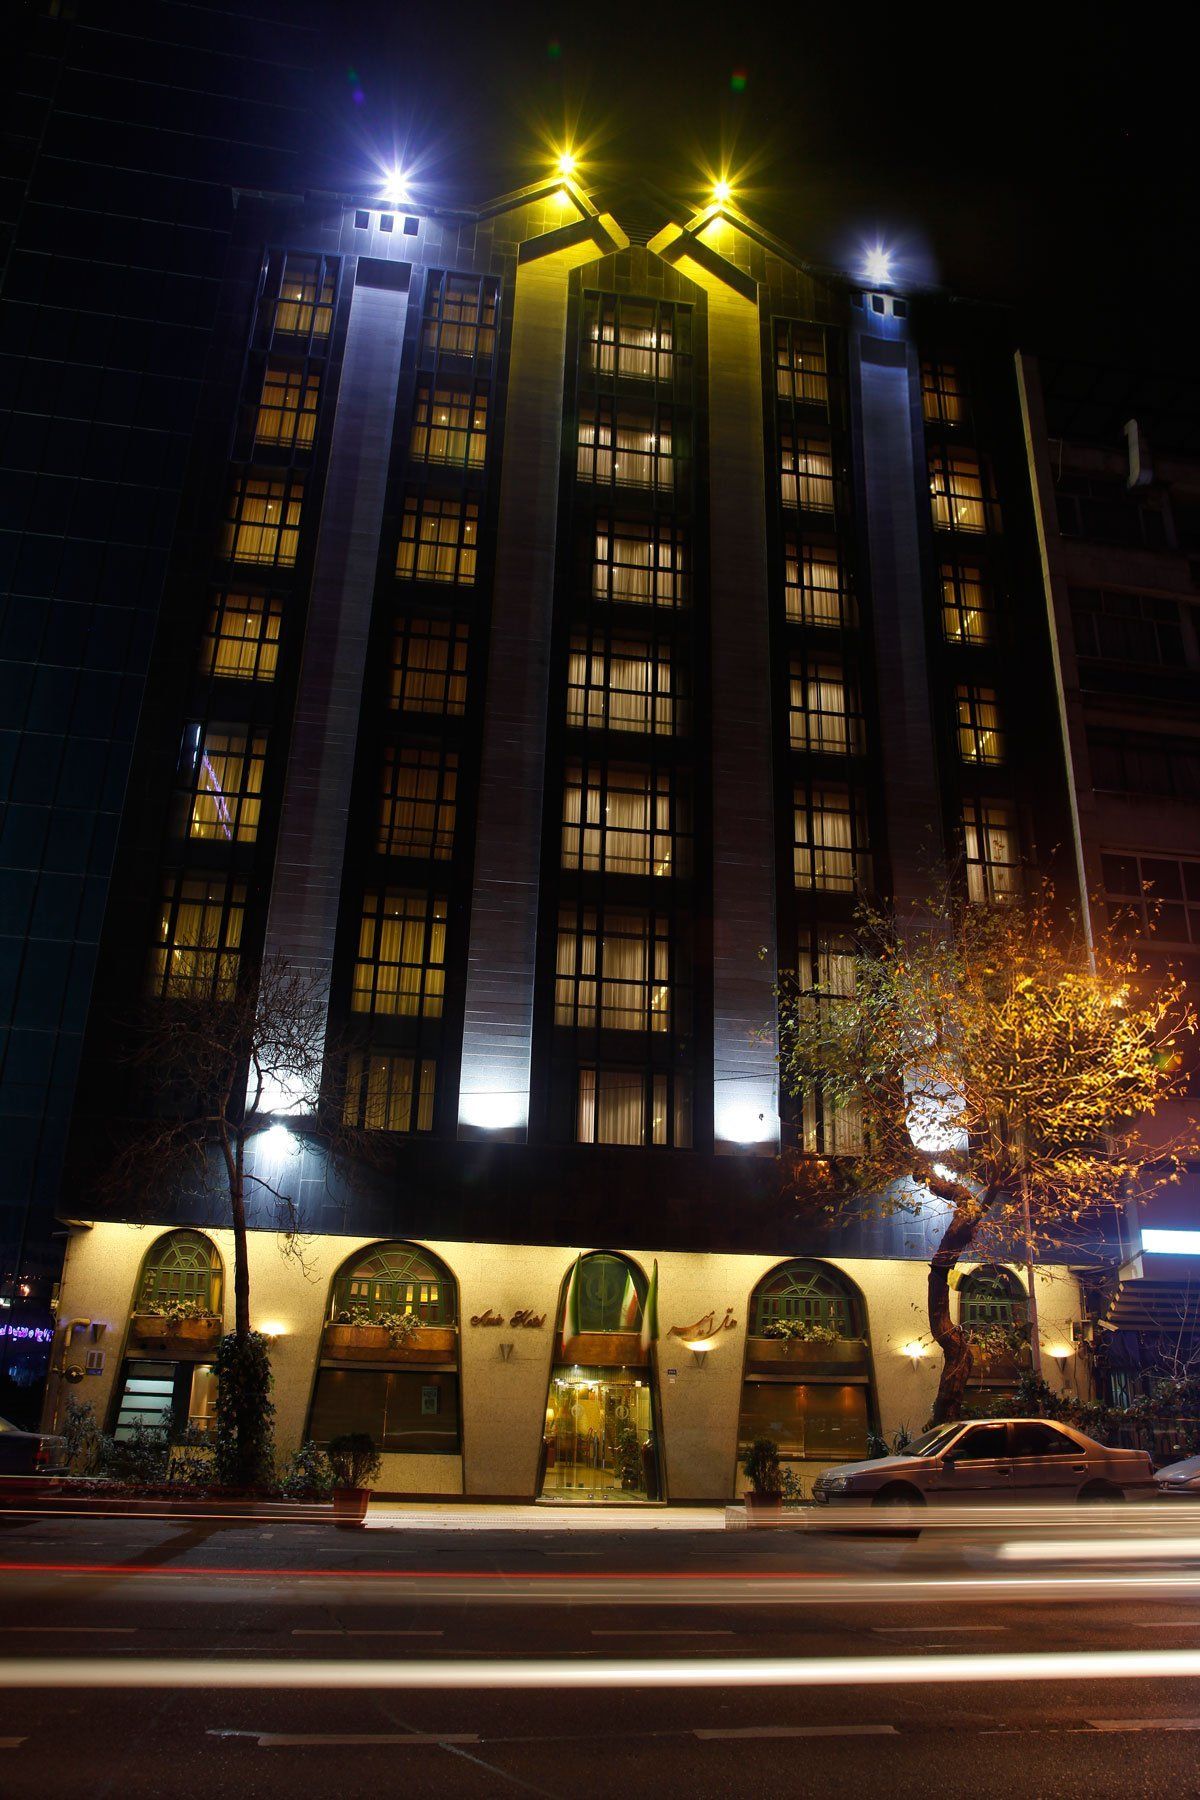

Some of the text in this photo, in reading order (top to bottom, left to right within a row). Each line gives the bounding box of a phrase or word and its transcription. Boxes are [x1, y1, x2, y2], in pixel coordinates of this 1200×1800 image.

[470, 1308, 547, 1328] Amir Hotel
[681, 1307, 738, 1342] هتل
